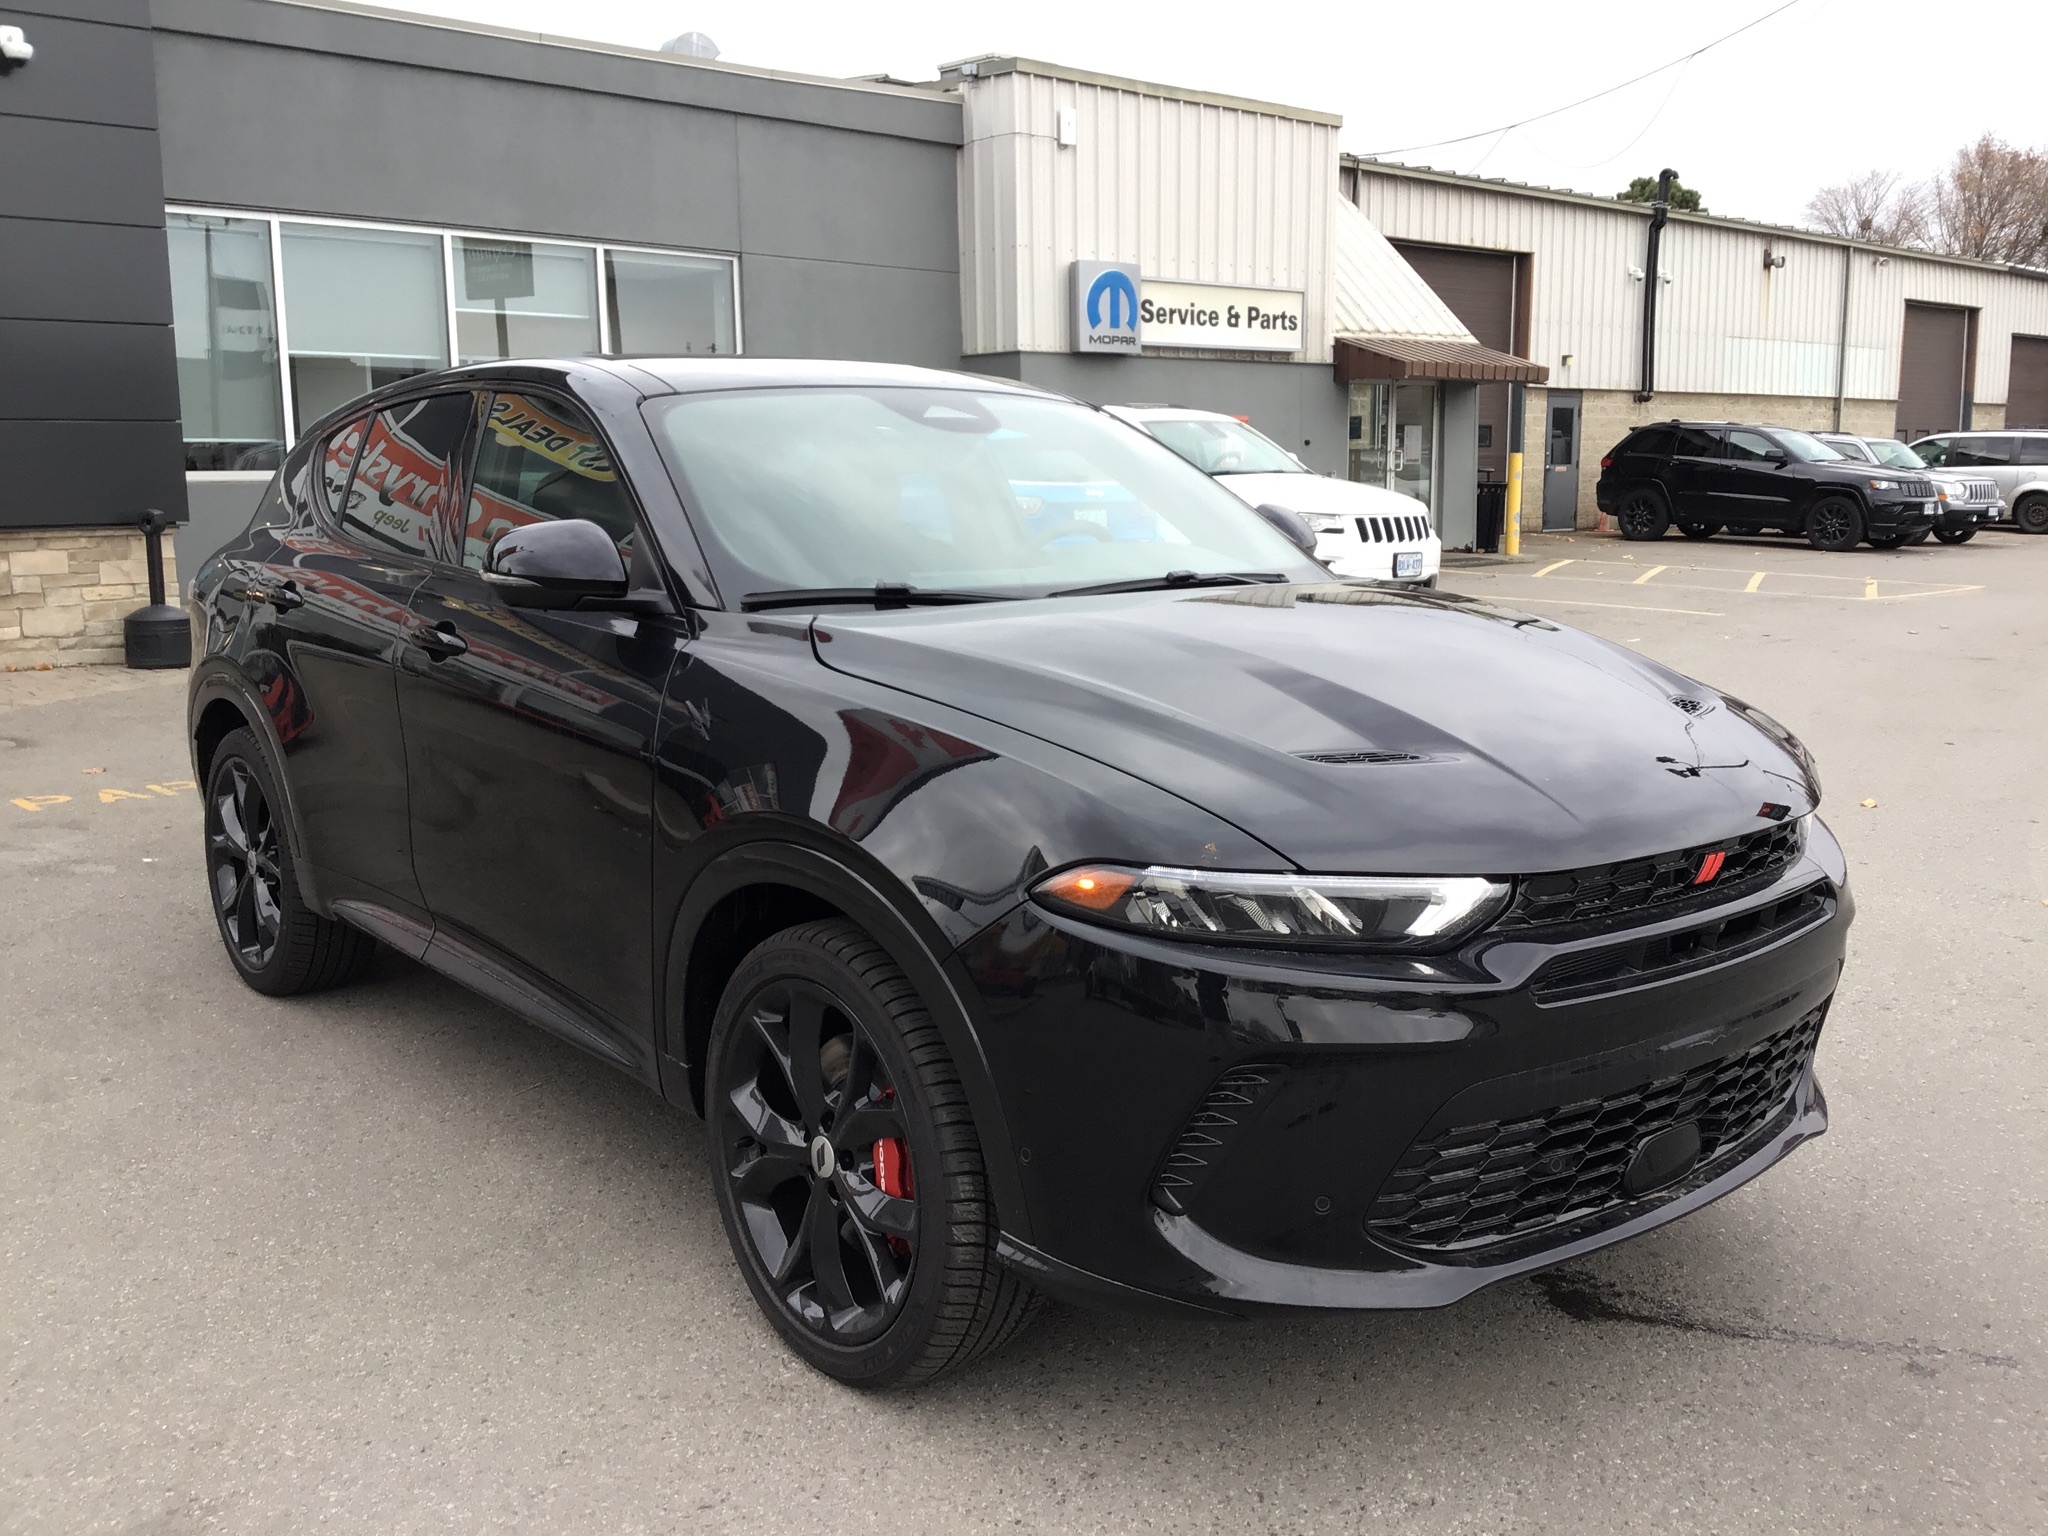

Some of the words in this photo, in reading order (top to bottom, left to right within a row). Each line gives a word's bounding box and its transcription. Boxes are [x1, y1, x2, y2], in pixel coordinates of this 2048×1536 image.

[1140, 298, 1220, 327] Service
[1227, 305, 1241, 329] &
[1247, 305, 1299, 332] Parts
[1088, 333, 1137, 346] MOPAR
